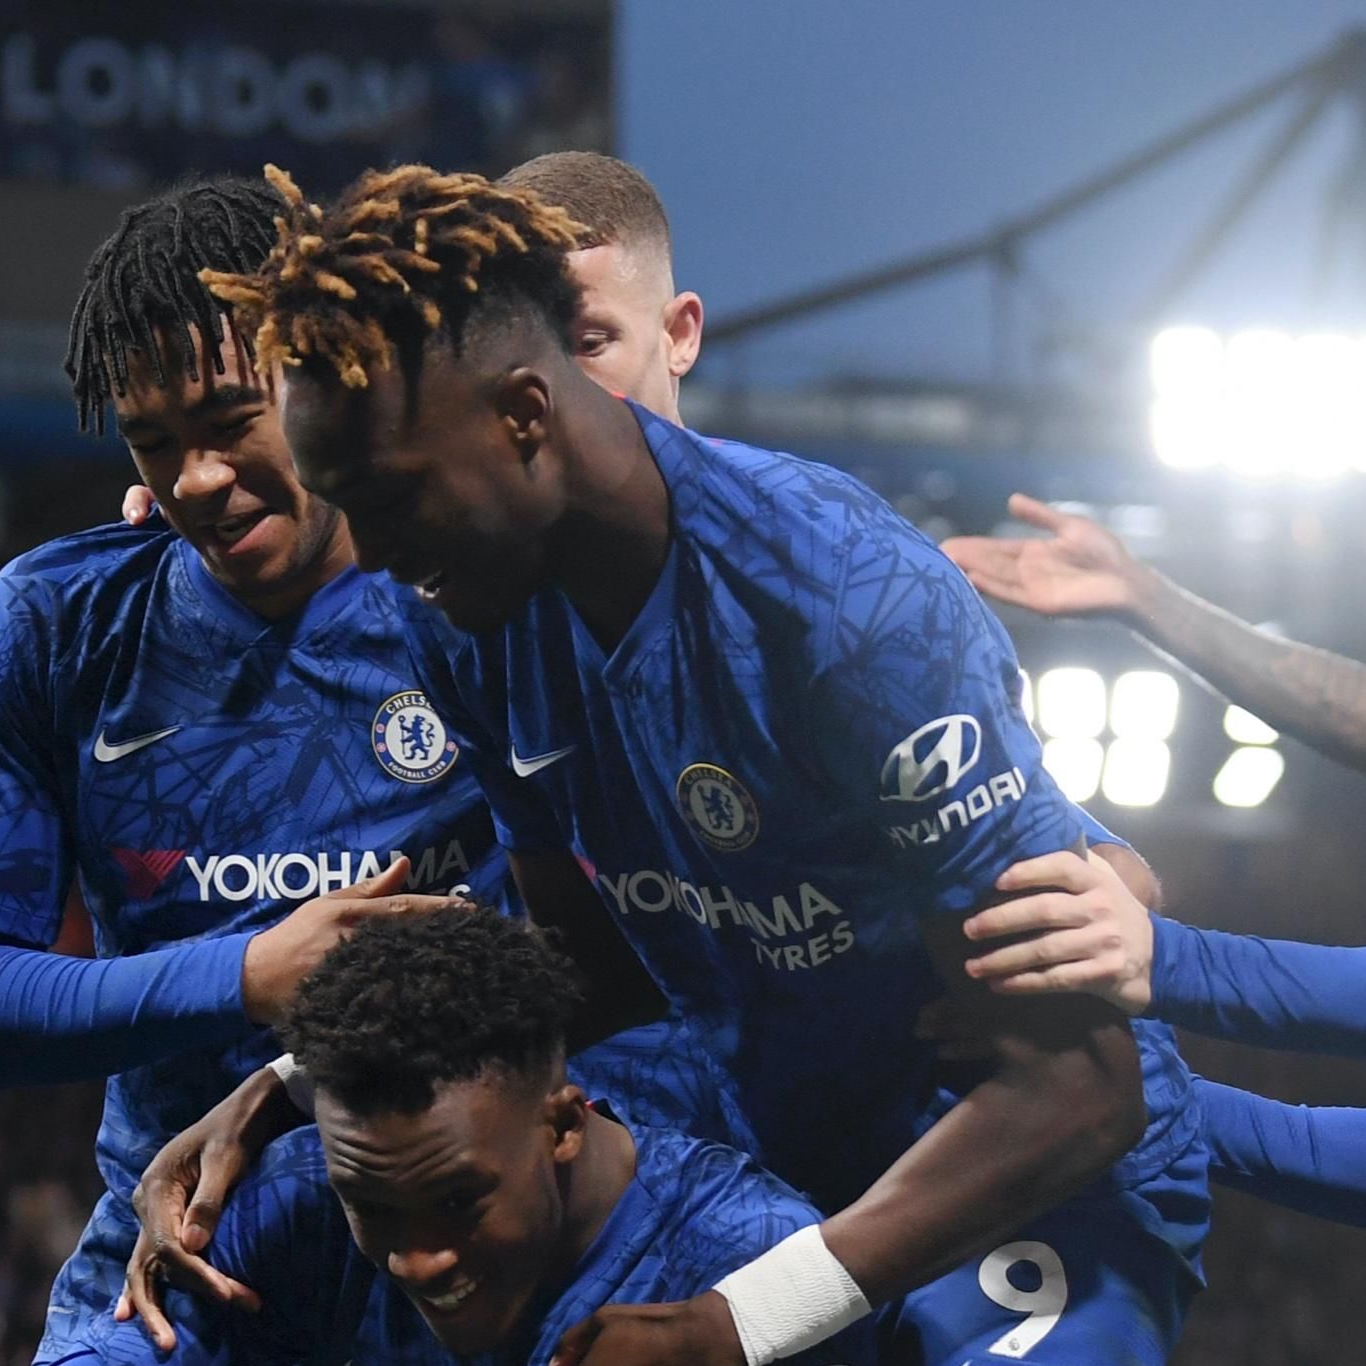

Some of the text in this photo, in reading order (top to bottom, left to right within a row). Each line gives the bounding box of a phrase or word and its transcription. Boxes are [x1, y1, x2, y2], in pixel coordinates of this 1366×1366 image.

[2, 36, 432, 142] LONDON
[385, 695, 435, 715] CHELS
[750, 920, 854, 971] TYRES
[978, 1240, 1068, 1359] 9
